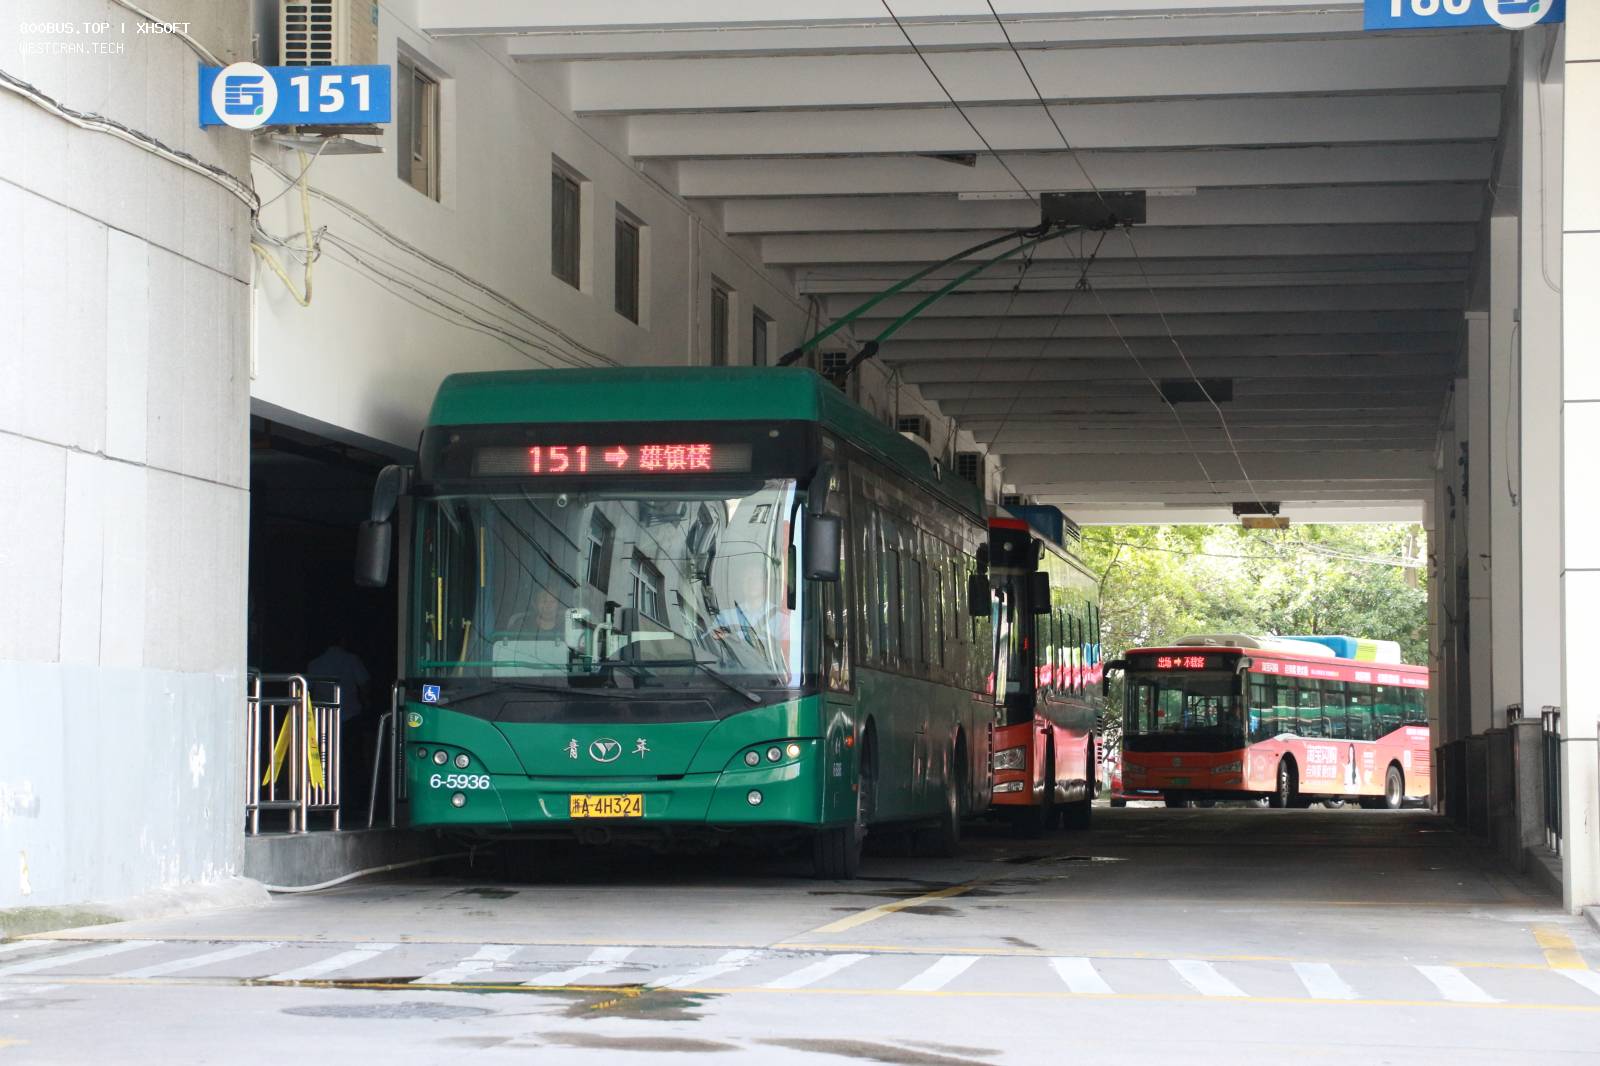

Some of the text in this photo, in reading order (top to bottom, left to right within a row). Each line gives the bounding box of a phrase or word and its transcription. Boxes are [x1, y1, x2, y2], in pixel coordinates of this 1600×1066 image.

[290, 75, 370, 113] 151
[530, 446, 587, 472] 151
[430, 774, 490, 790] 6-5936
